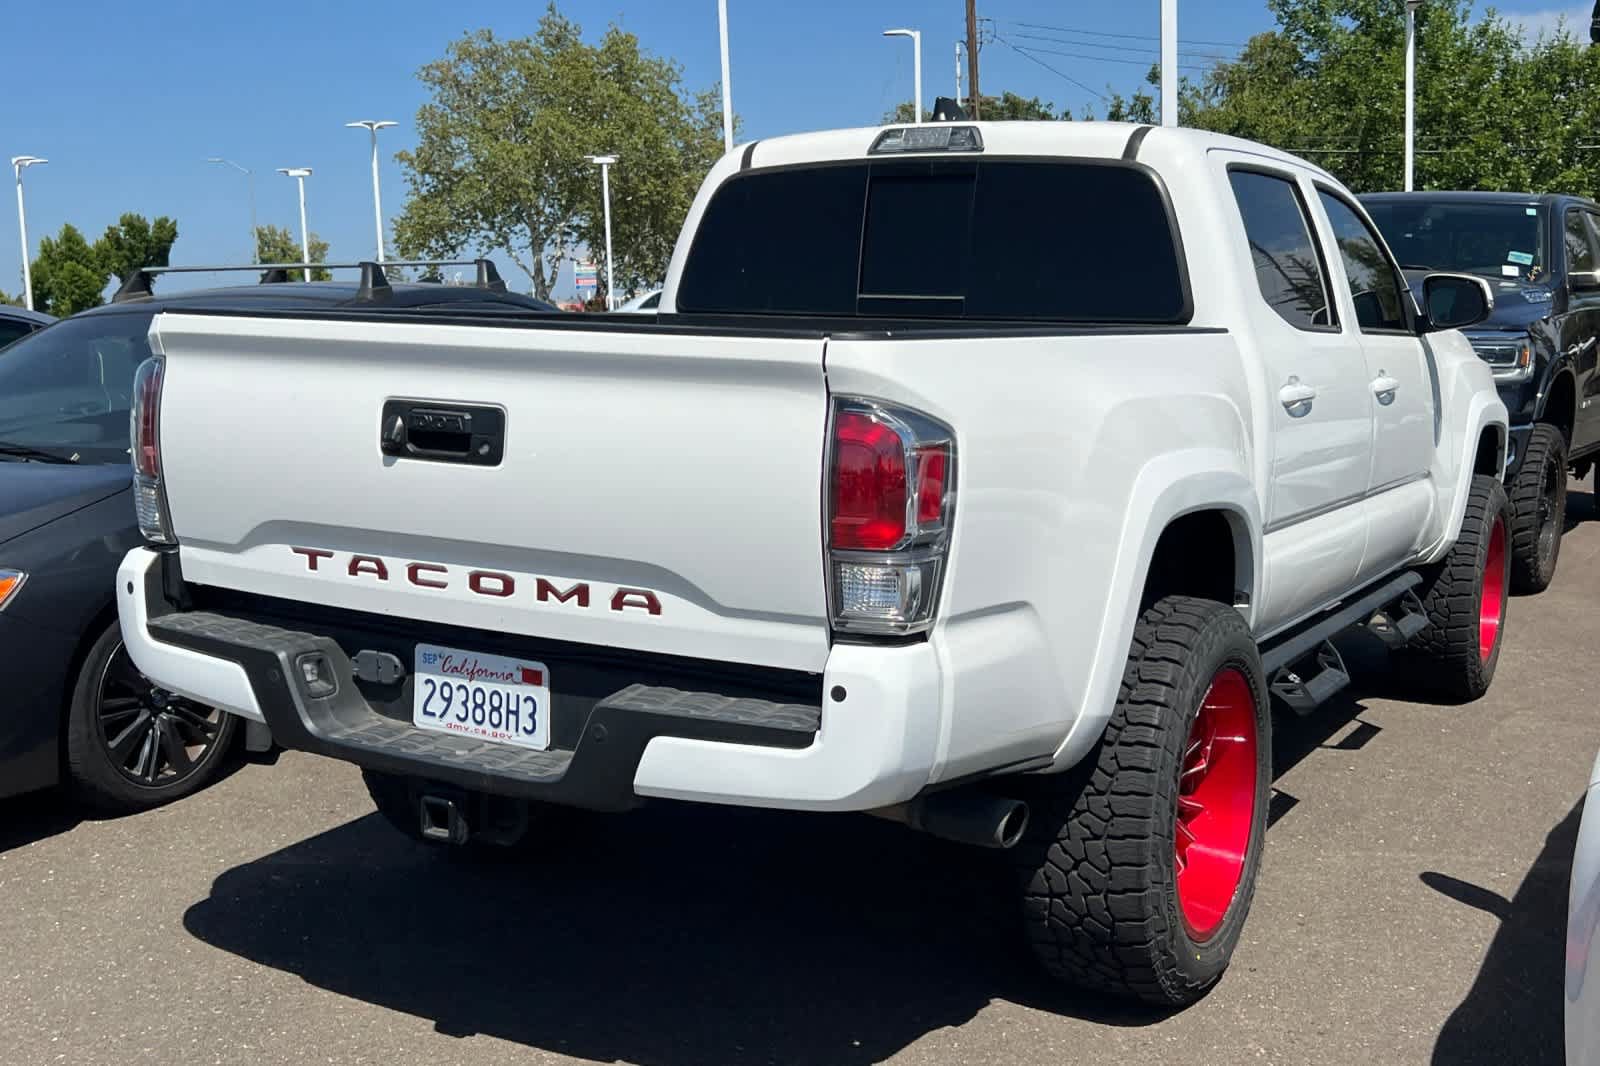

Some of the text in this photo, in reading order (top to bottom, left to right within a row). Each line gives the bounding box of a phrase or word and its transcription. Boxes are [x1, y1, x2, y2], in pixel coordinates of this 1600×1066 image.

[292, 547, 661, 615] TACOMA
[422, 652, 438, 665] SEP
[441, 655, 519, 683] California
[422, 678, 537, 735] 29388H3
[445, 722, 513, 740] dmv.ca.gov
